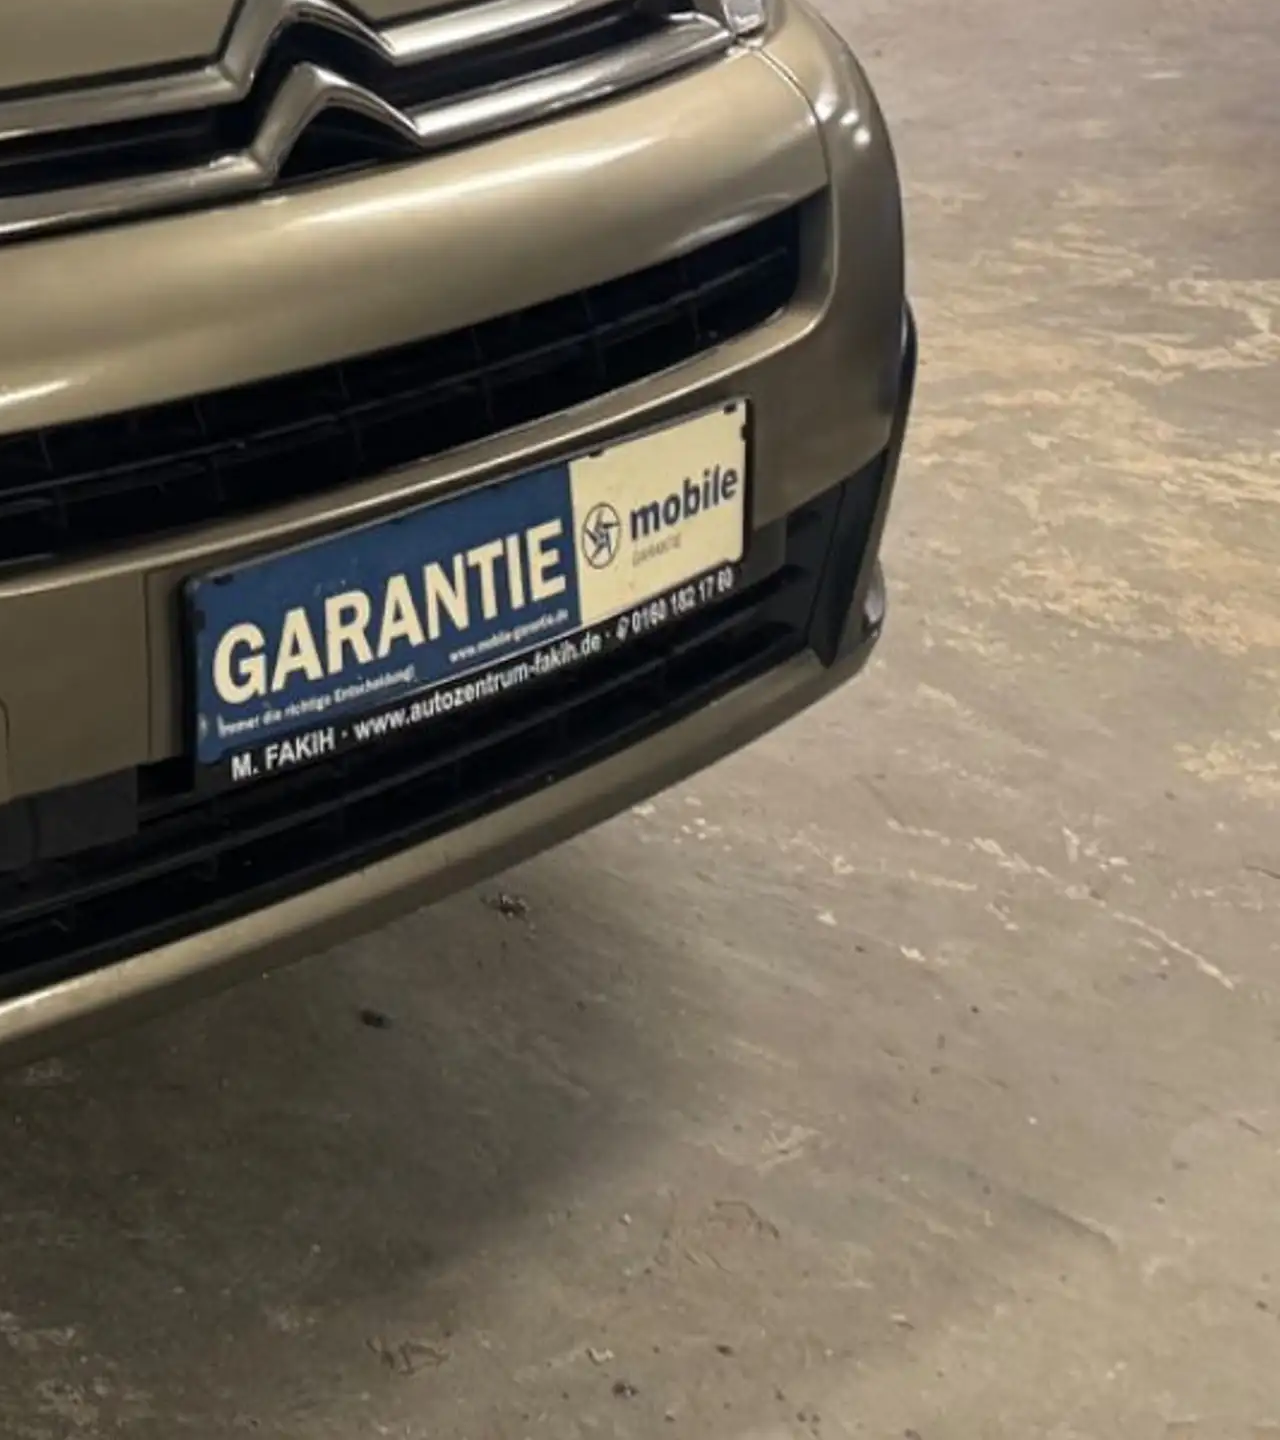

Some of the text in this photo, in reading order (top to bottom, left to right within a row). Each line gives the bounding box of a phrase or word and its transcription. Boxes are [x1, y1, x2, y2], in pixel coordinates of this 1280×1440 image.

[629, 464, 739, 541] mobile
[212, 517, 567, 706] GARANTIE
[231, 752, 259, 781] M.
[265, 726, 336, 770] FAKIH
[352, 631, 602, 742] www.autozentrum-fakih.de
[698, 575, 715, 602] 17
[262, 708, 282, 725] die
[284, 694, 333, 717] richtige
